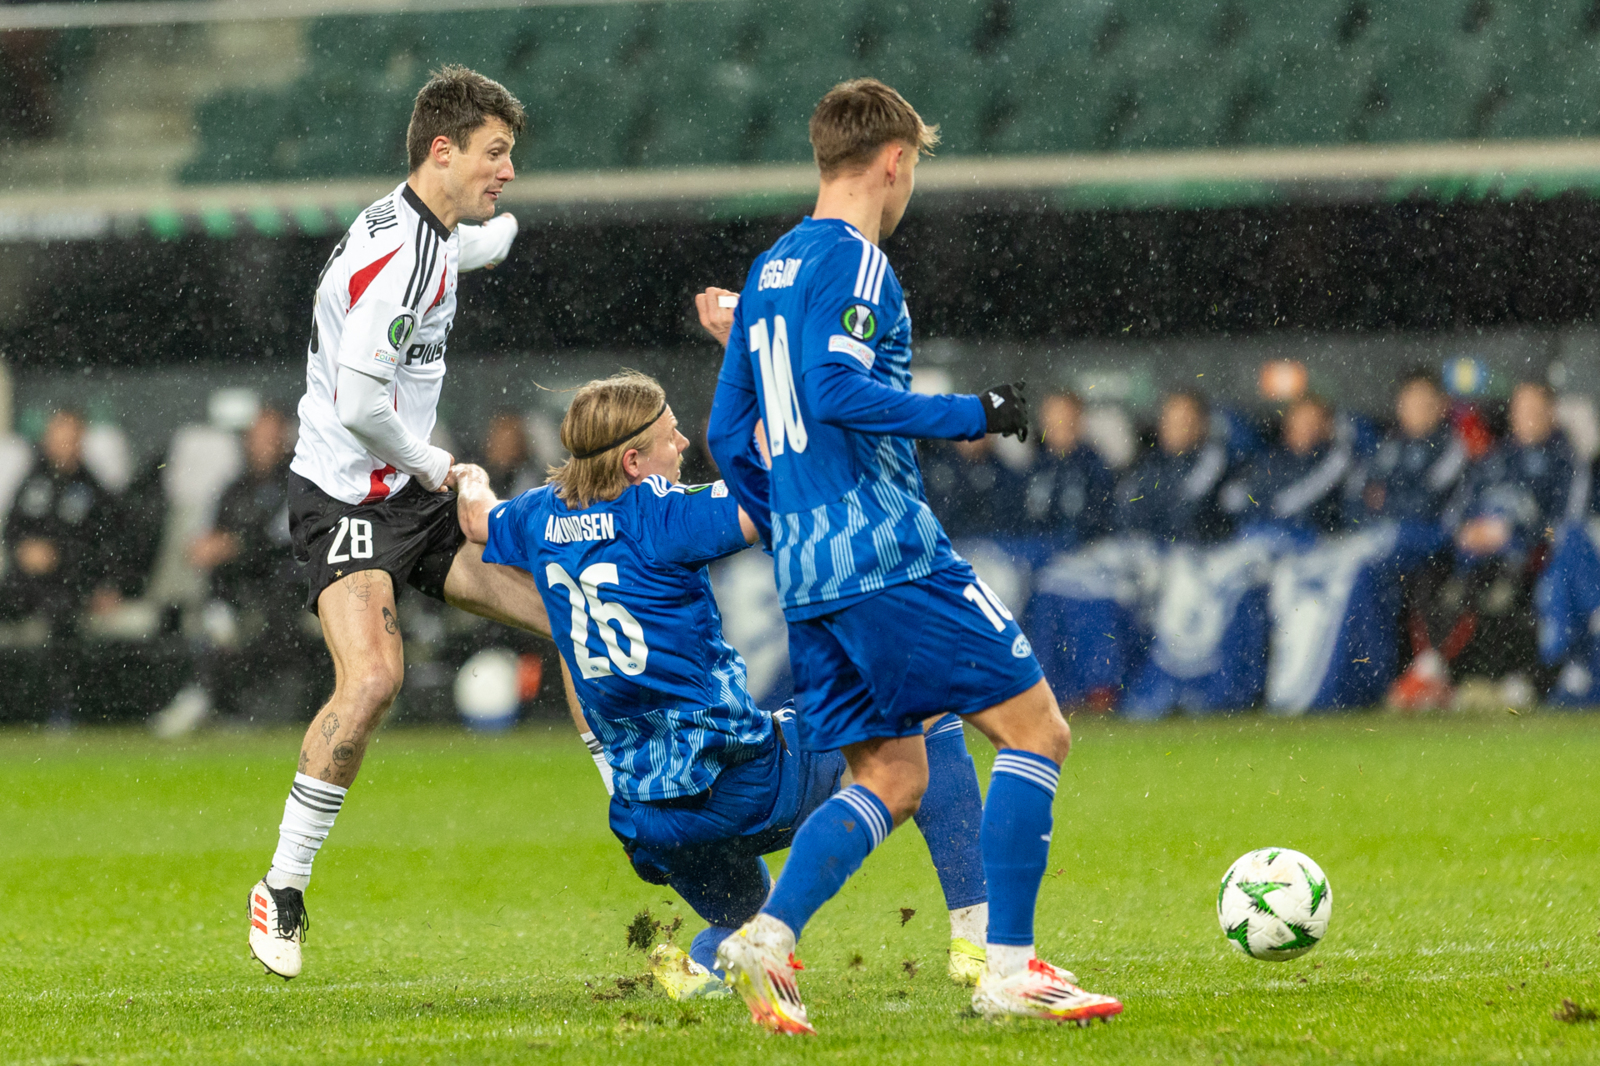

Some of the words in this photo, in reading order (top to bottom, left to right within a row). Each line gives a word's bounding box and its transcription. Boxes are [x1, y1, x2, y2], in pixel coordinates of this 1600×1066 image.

[749, 315, 808, 457] 10
[327, 517, 373, 564] 28
[546, 562, 648, 679] 26
[963, 576, 1013, 633] 10
